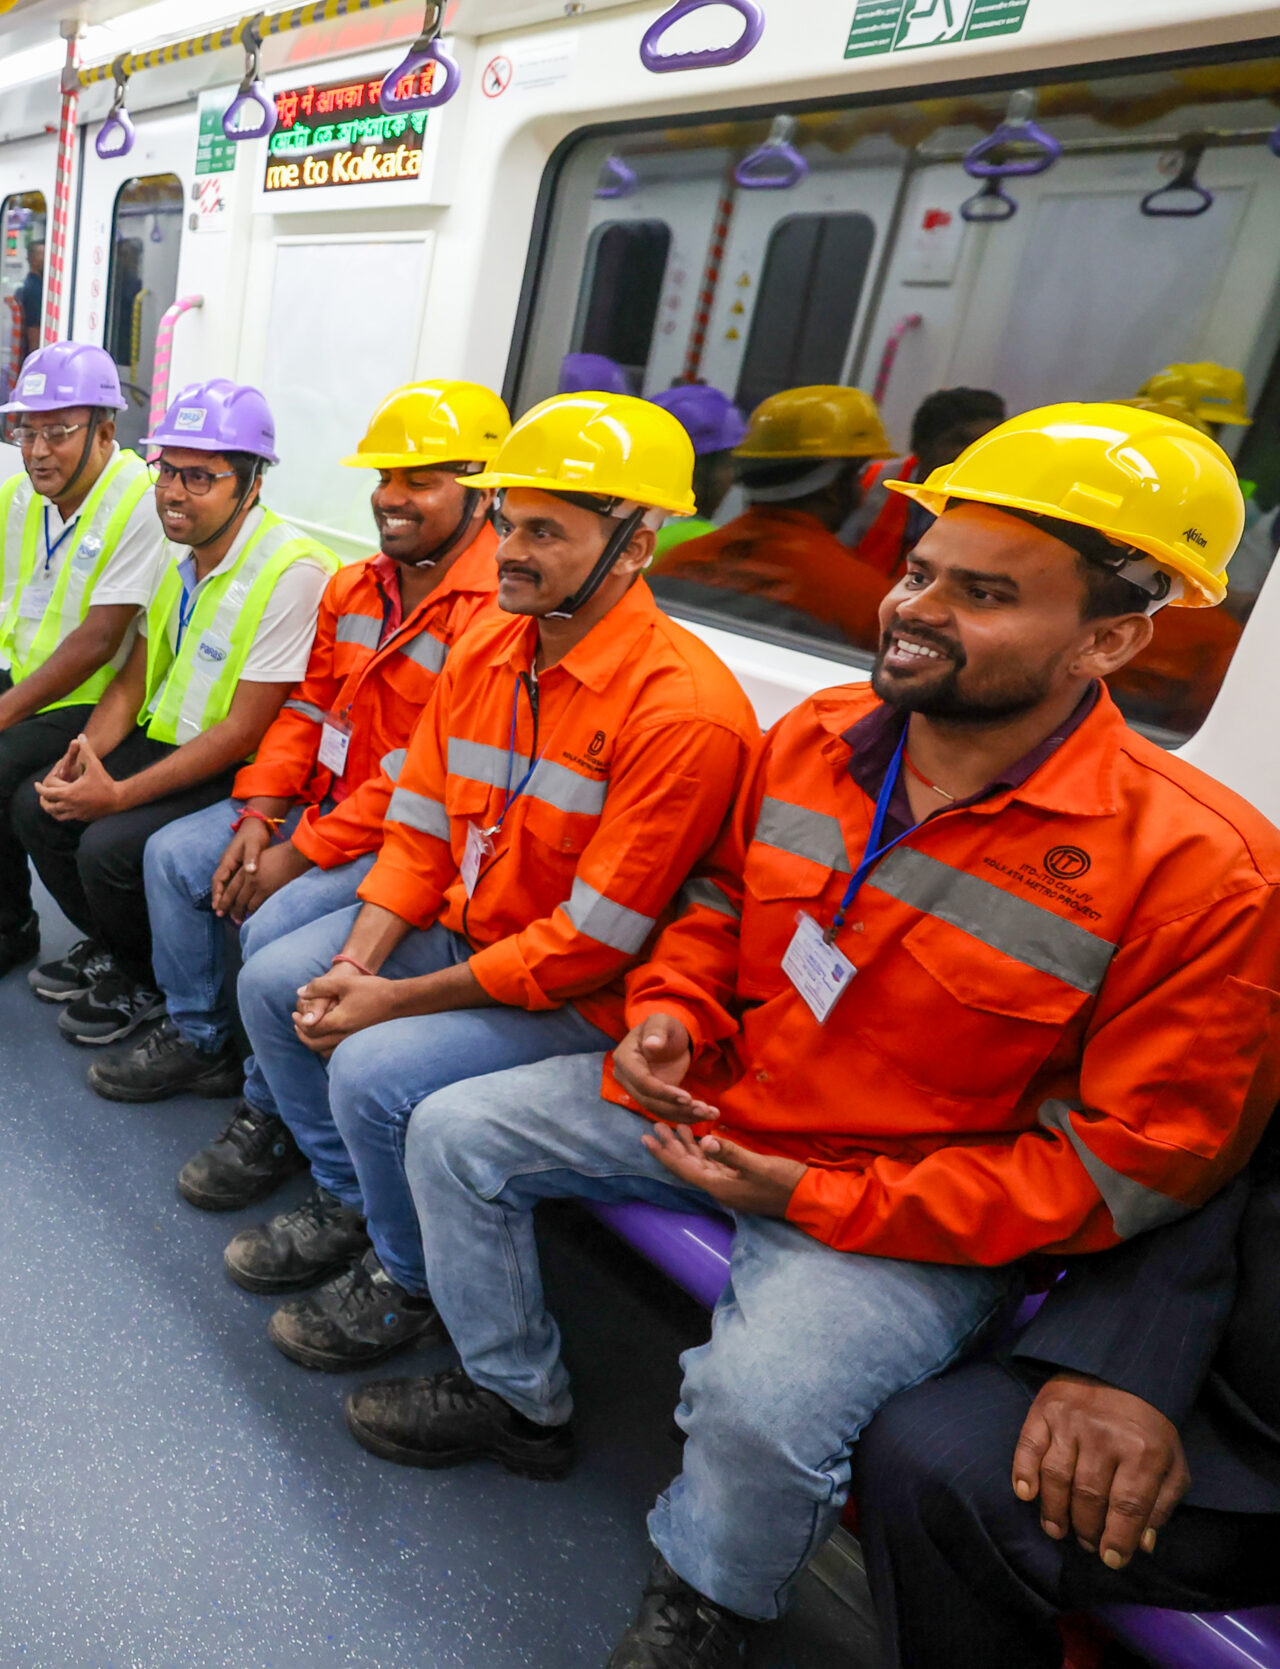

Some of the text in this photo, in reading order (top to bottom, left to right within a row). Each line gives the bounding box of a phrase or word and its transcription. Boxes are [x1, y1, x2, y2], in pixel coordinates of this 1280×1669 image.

[316, 84, 365, 113] आपका
[266, 144, 424, 190] me to Kolkata
[1025, 879, 1056, 899] METRO
[1057, 894, 1102, 921] PROJECT
